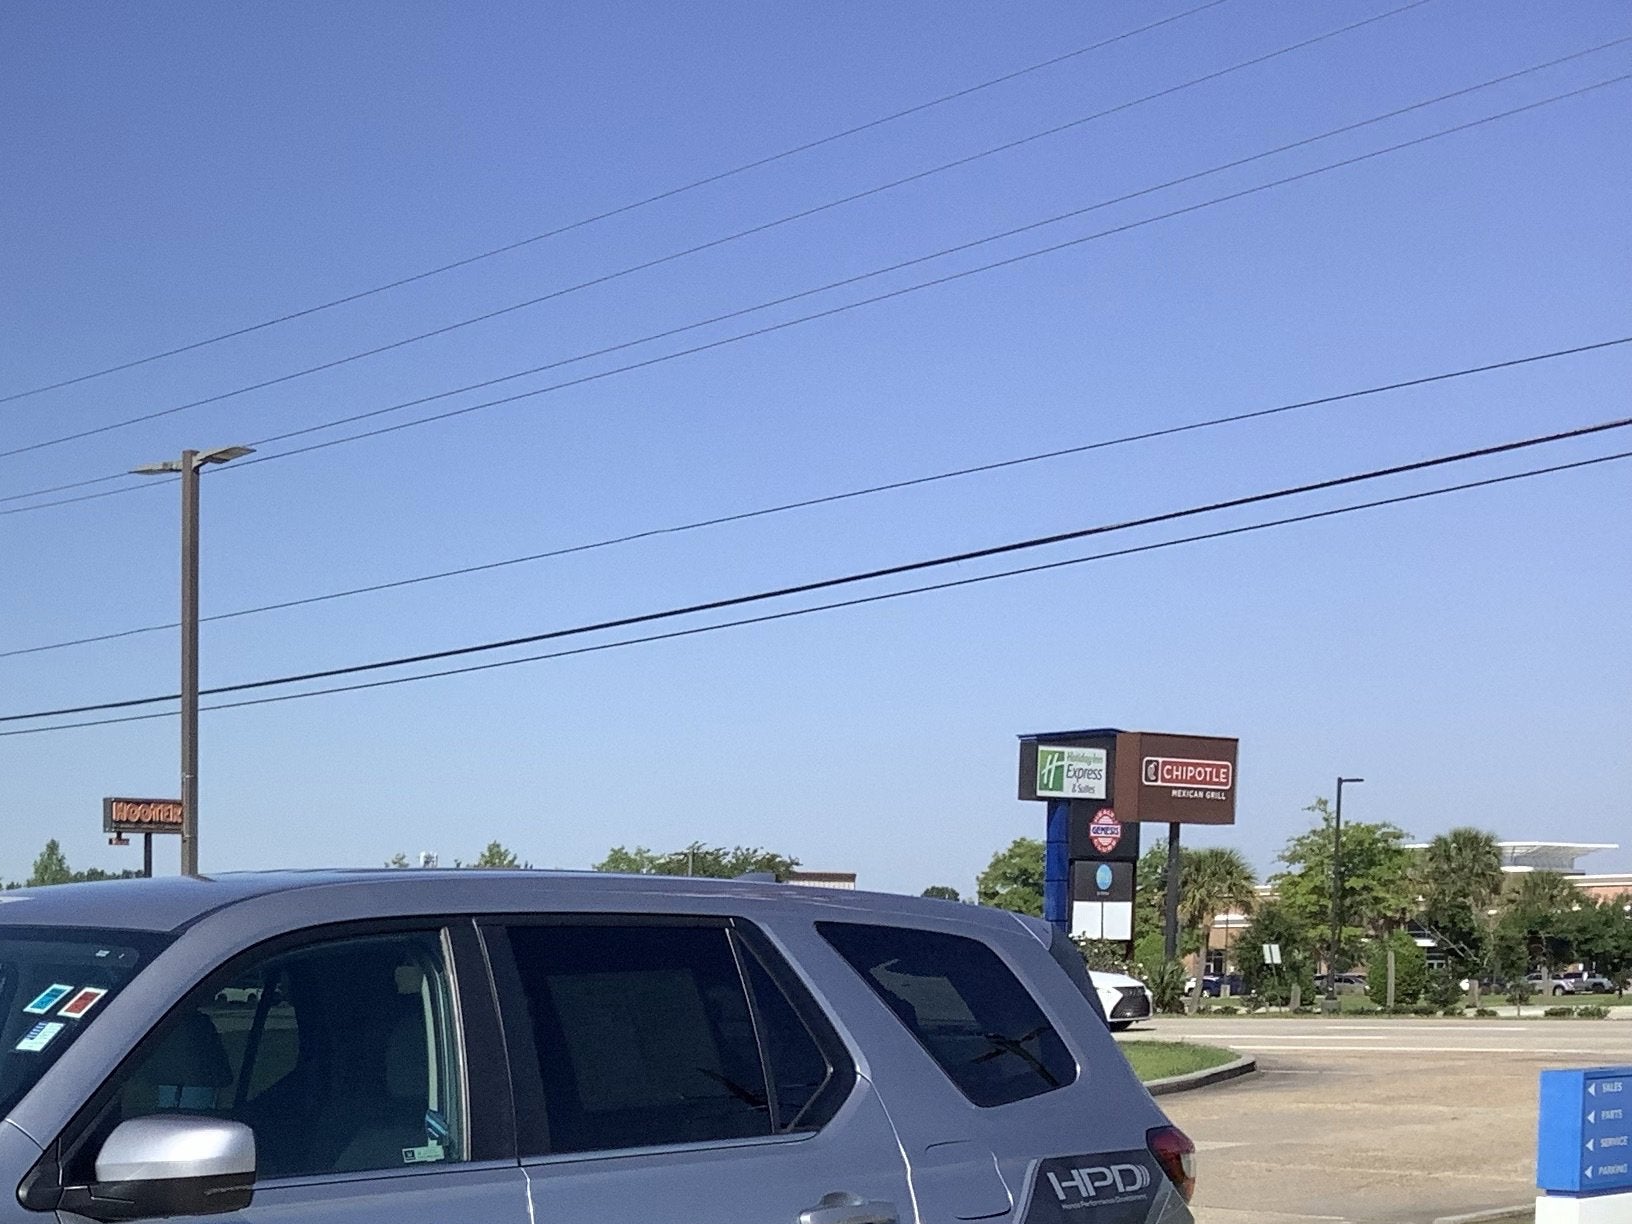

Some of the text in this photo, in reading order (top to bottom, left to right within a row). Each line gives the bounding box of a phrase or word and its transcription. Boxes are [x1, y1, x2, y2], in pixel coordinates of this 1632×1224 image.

[1066, 763, 1103, 783] Express
[1163, 765, 1228, 783] CHIPOTLE
[1171, 789, 1226, 800] MEXICAN GRILL
[112, 802, 183, 823] HOOTER
[1047, 1163, 1151, 1200] HPD
